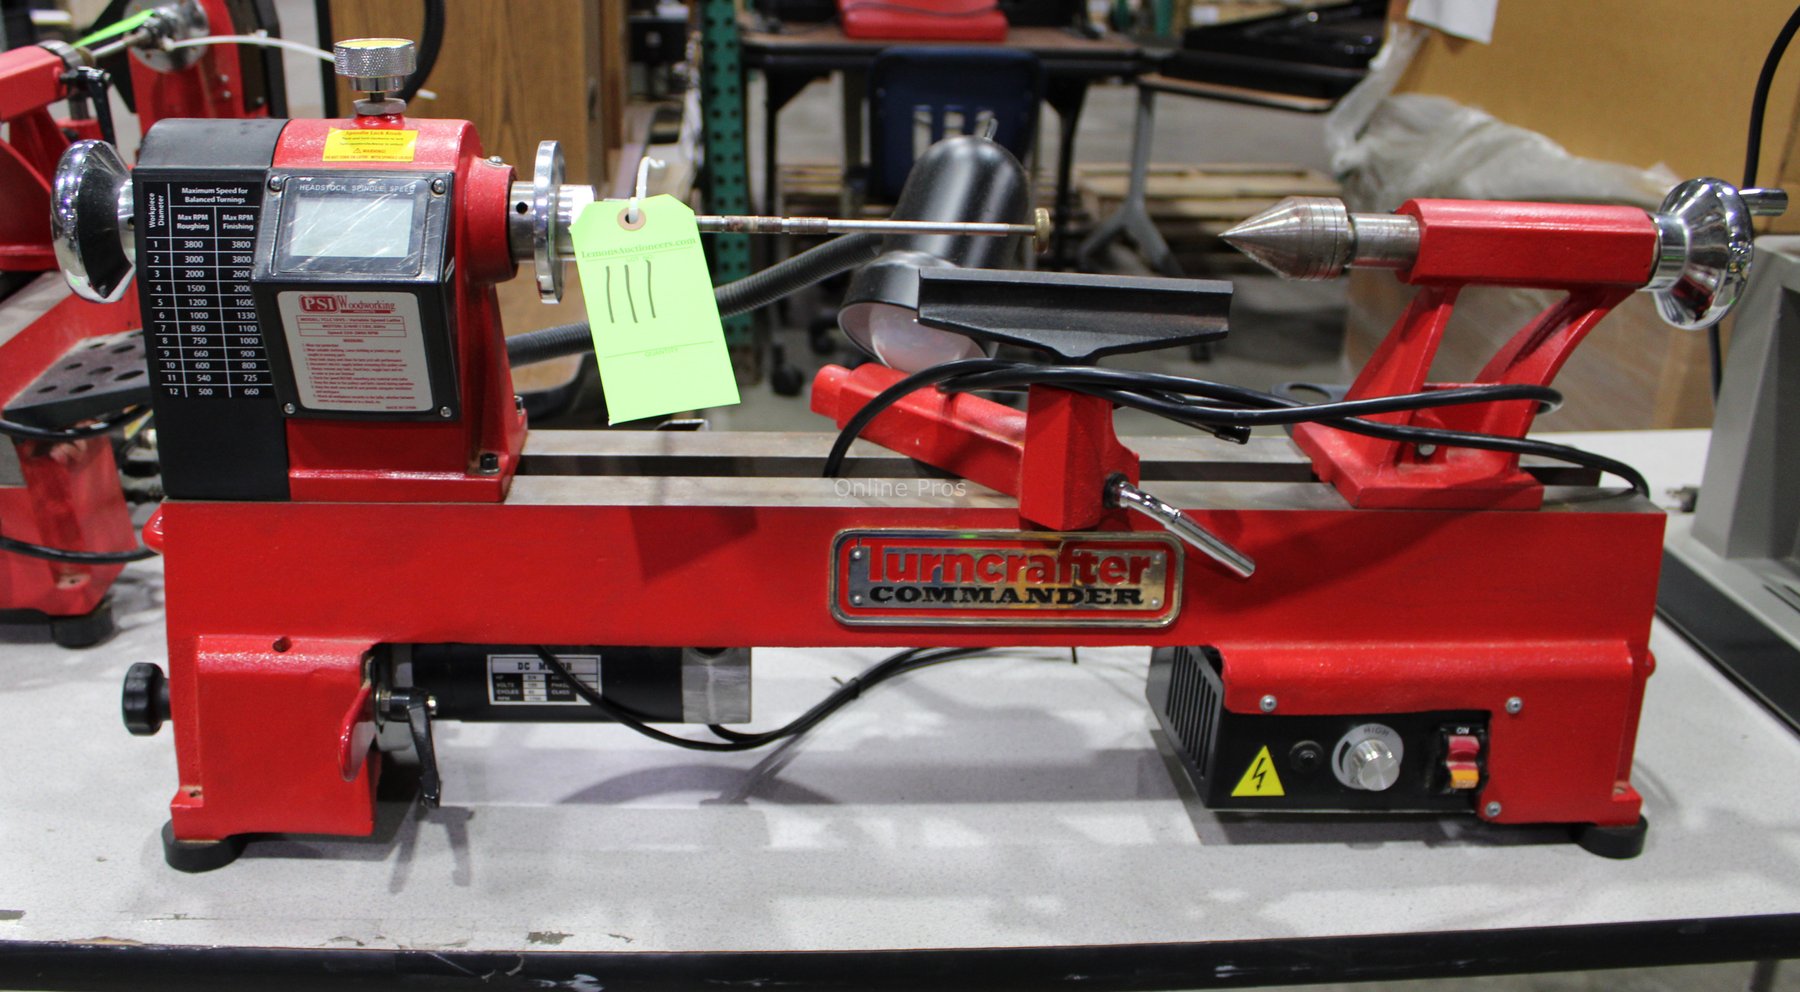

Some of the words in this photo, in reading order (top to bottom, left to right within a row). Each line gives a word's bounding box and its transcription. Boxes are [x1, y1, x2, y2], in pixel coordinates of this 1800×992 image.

[216, 187, 237, 196] Speed
[351, 184, 384, 192] SPINDLE
[216, 196, 245, 204] Turnings
[148, 192, 157, 228] Workpiece
[176, 223, 210, 231] Roughing
[223, 223, 254, 231] Finishing
[581, 238, 697, 258] LemonsAuctioneers.com
[185, 256, 204, 264] 3000
[232, 256, 251, 264] 3800
[155, 270, 160, 278] 3
[185, 270, 204, 278] 2000
[304, 297, 336, 311] PSI
[337, 295, 396, 311] Woodworking
[864, 540, 1152, 585] Turncrafter
[869, 586, 1144, 605] COMMANDER
[517, 662, 530, 670] DC
[539, 662, 572, 670] MOR
[1363, 727, 1390, 737] HIGH
[1456, 727, 1470, 735] ON
